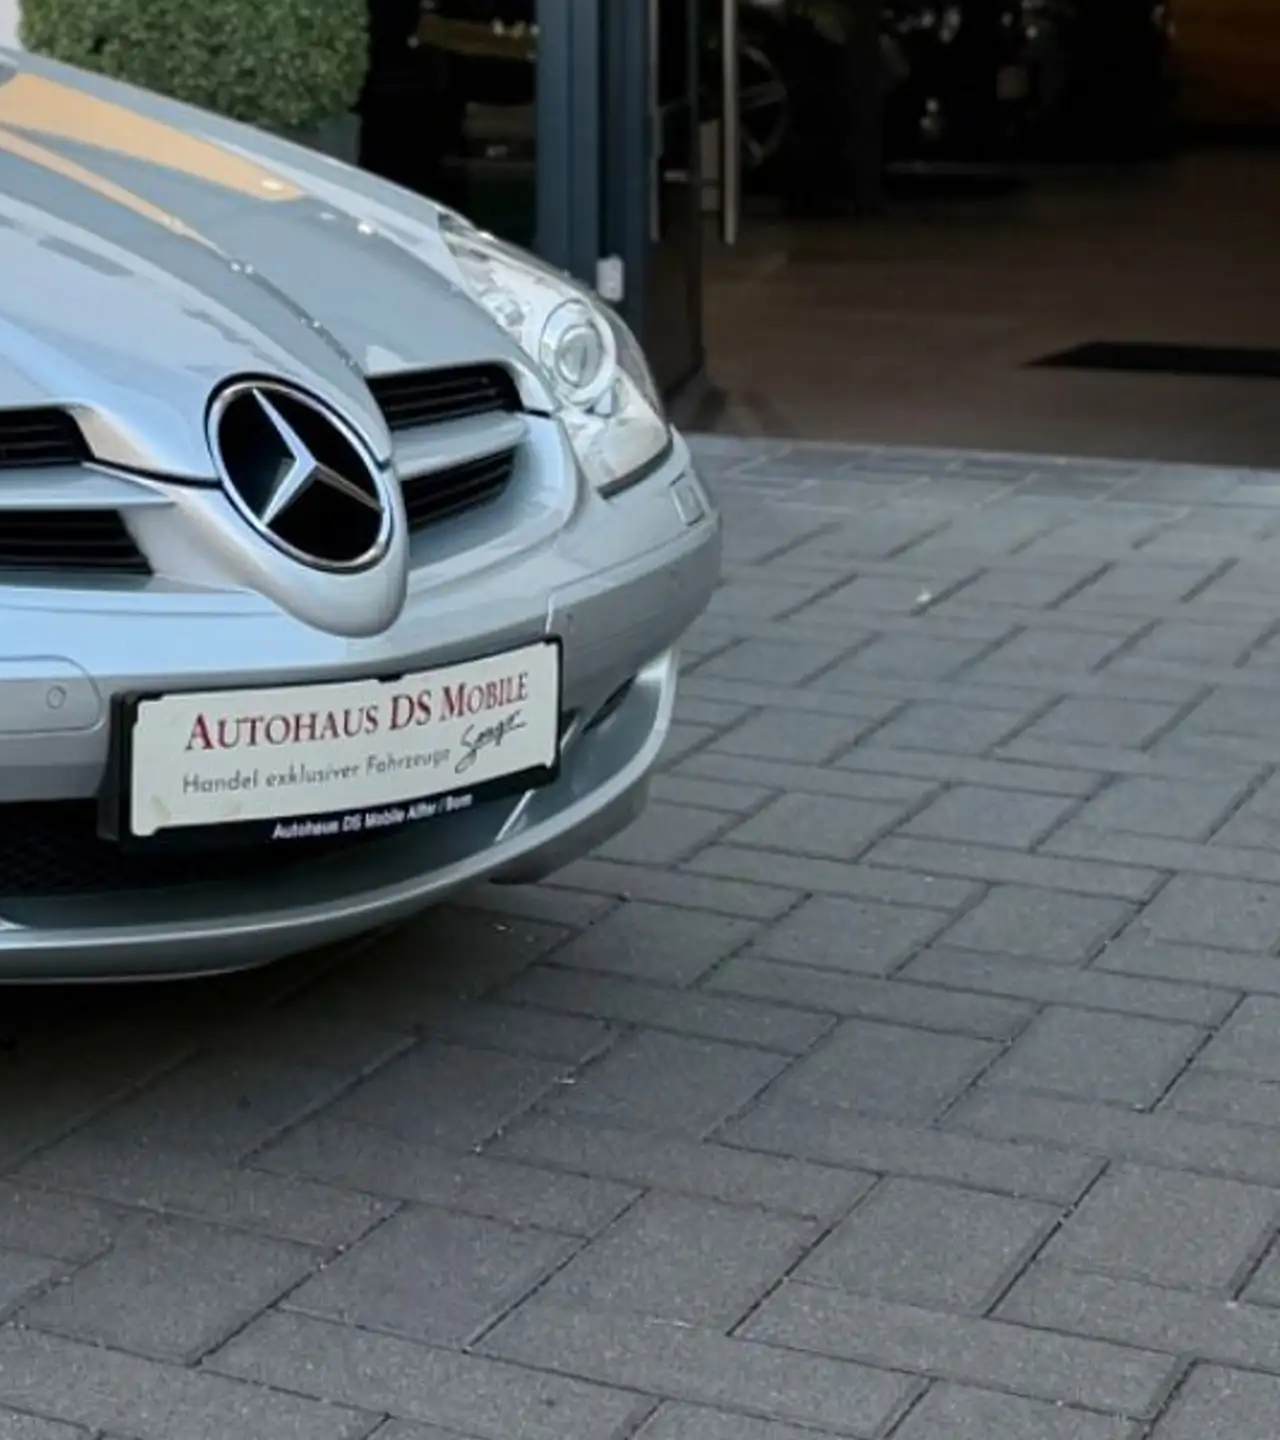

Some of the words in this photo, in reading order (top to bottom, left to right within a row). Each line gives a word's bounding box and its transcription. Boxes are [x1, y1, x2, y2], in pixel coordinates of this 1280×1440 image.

[185, 705, 379, 751] AUTOHAUS
[388, 691, 432, 731] DS
[439, 671, 528, 722] MOBILE
[183, 768, 259, 793] Handel
[266, 760, 360, 787] exklusiver
[273, 821, 339, 839] Autohaus
[342, 813, 361, 832] DS
[365, 809, 405, 829] Mobile
